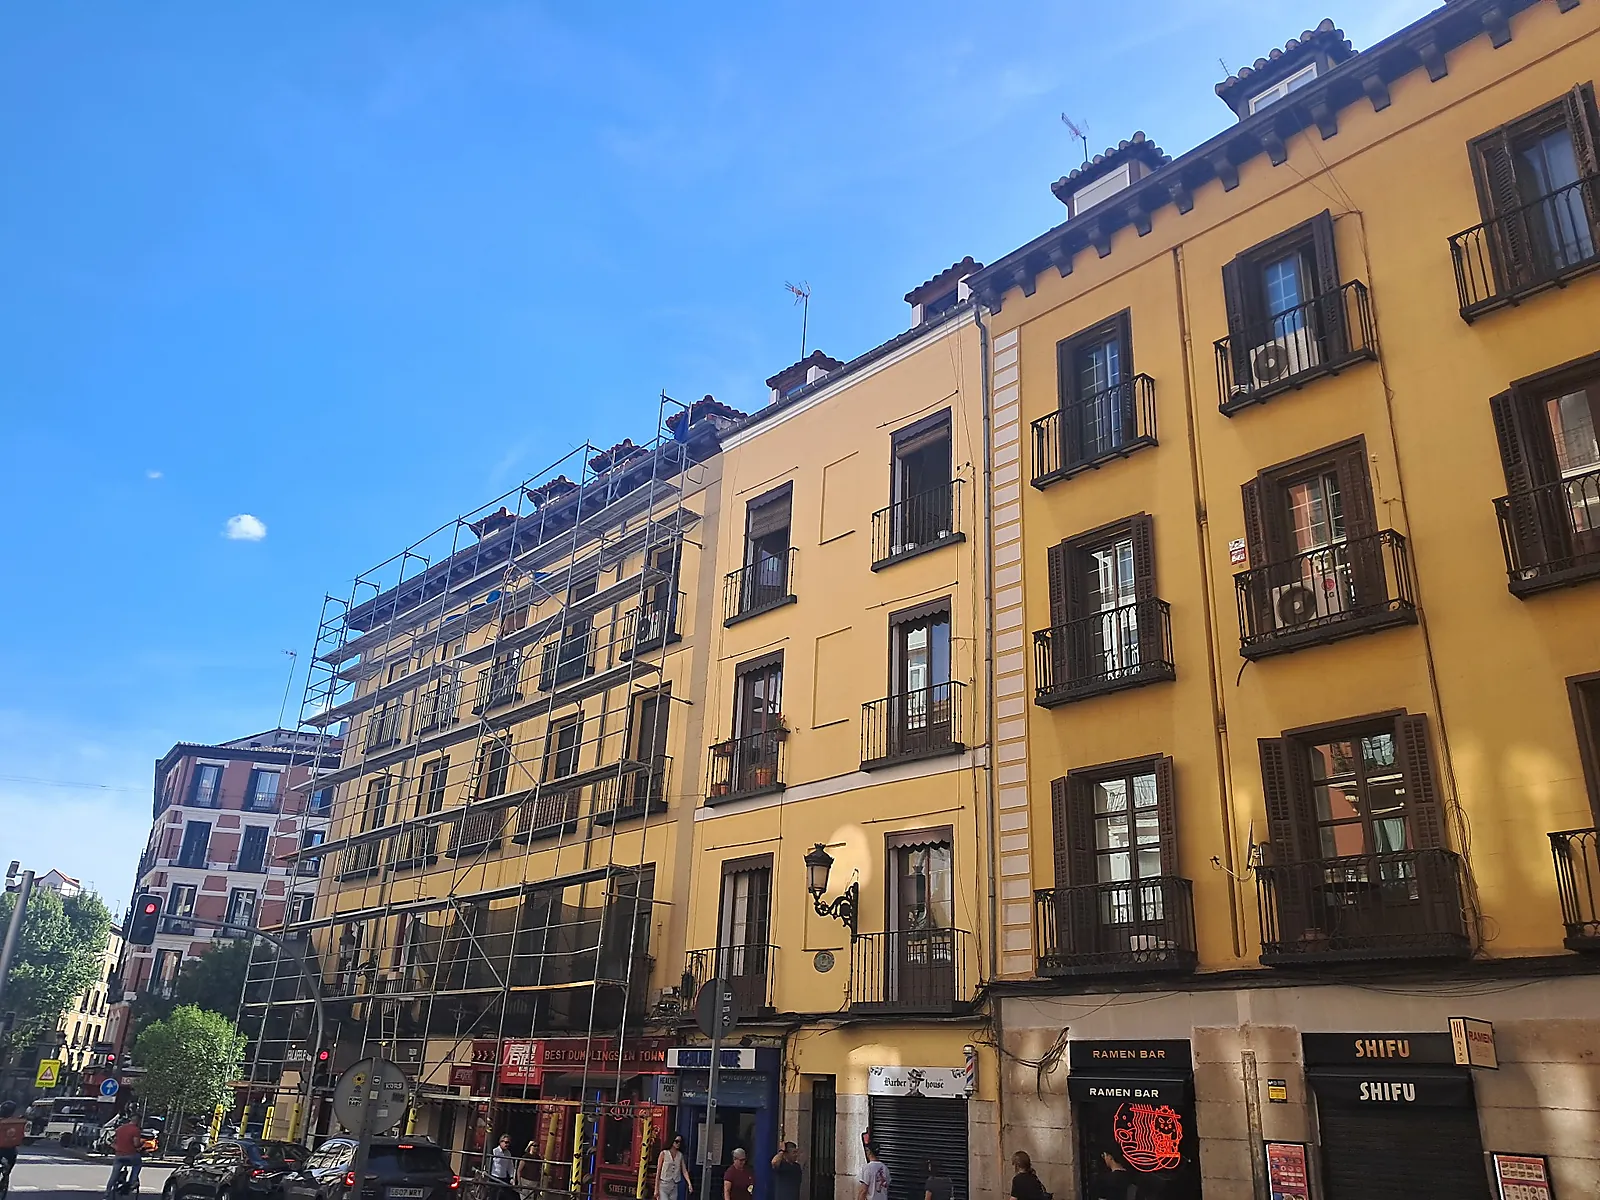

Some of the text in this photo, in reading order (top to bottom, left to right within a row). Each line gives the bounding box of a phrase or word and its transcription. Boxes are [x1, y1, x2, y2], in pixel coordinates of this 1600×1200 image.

[1468, 1030, 1492, 1044] RAMEN
[1092, 1050, 1166, 1059] RAMEN BAR
[1355, 1039, 1410, 1058] SHIFU
[544, 1050, 565, 1060] BEST
[640, 1050, 664, 1062] TOWN
[663, 1084, 675, 1093] POKE
[884, 1077, 944, 1089] Barber house
[1089, 1087, 1159, 1098] RAMEN BAR
[1360, 1082, 1416, 1102] SHIFU
